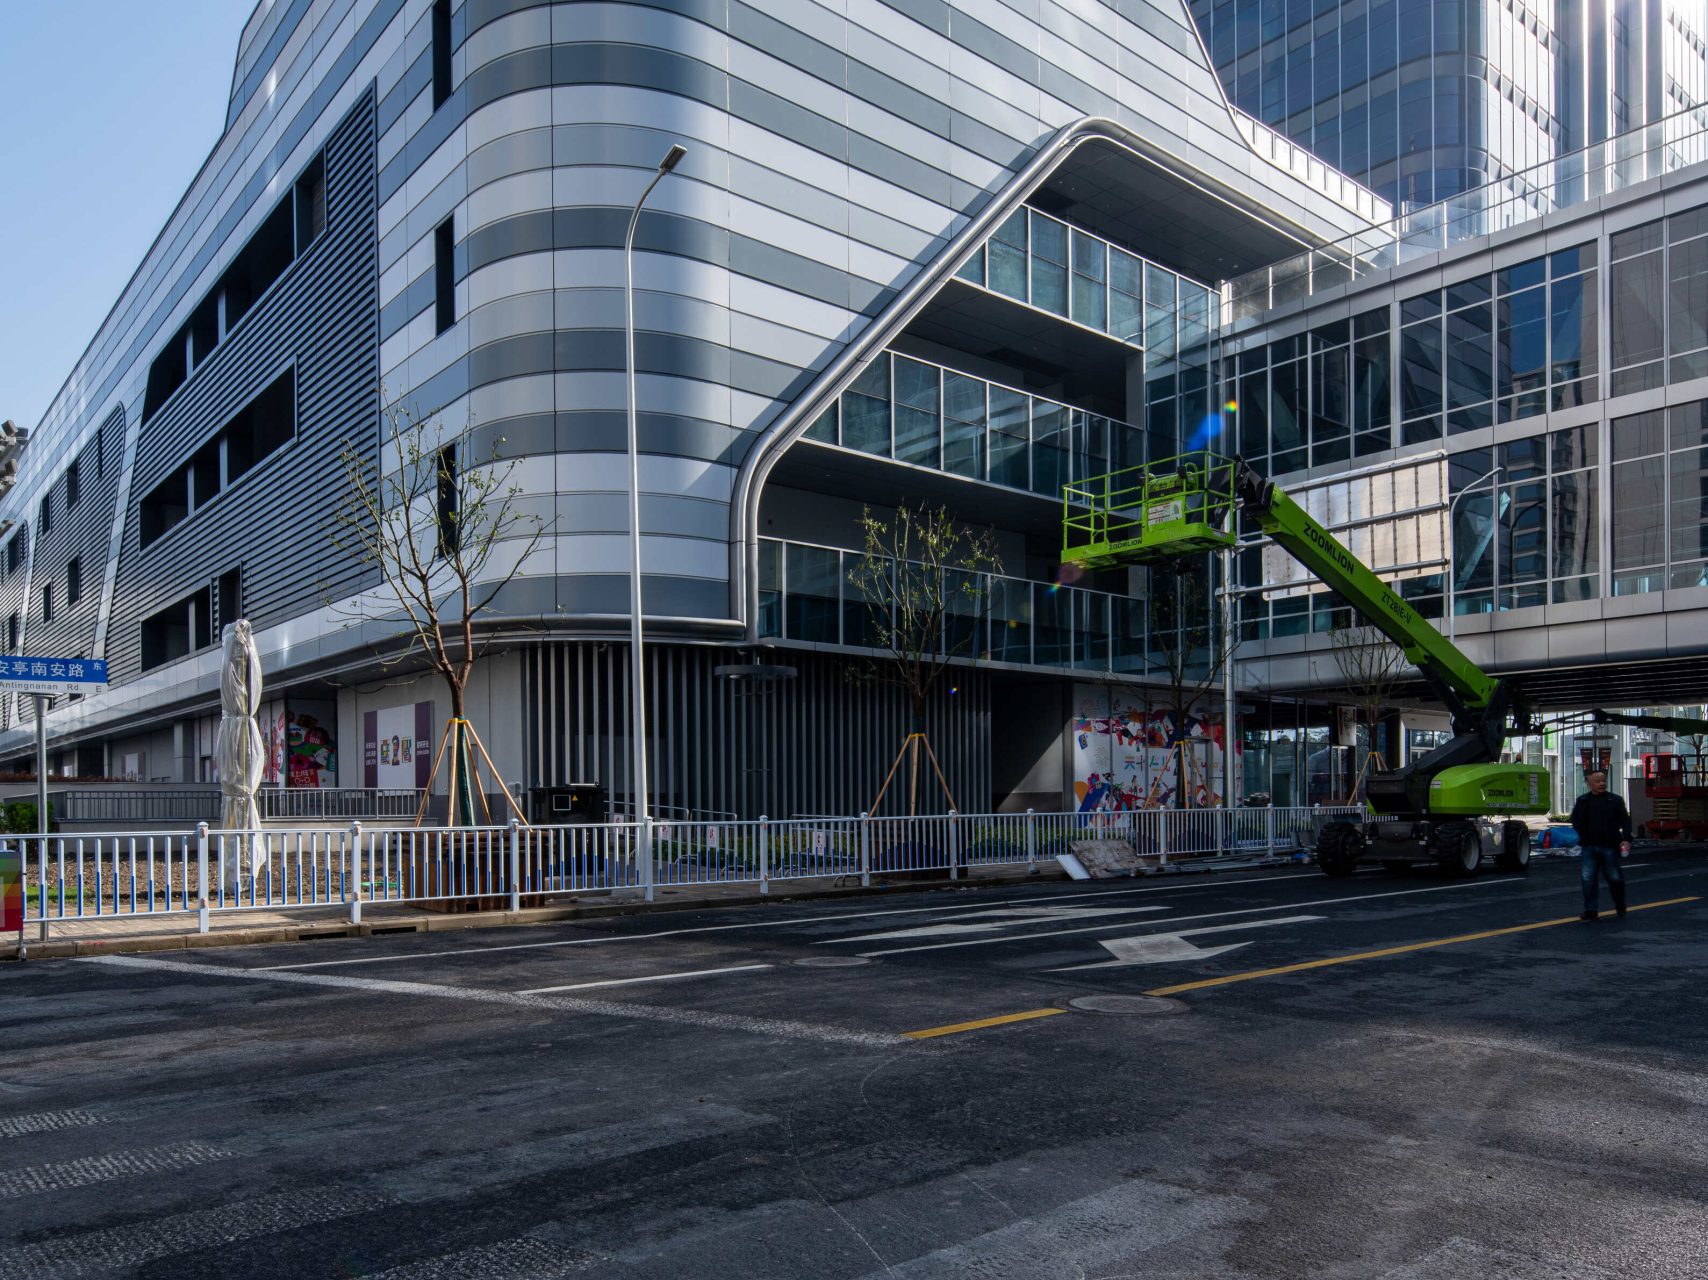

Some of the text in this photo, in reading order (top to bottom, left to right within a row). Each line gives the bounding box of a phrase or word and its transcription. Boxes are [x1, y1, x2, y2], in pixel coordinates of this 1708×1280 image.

[1108, 538, 1143, 551] ZOOMLION
[1303, 522, 1354, 575] ZOOMLION
[0, 660, 84, 678] 安亭南安路
[93, 662, 102, 671] 东
[0, 681, 58, 690] Antingnanan
[95, 685, 103, 693] E
